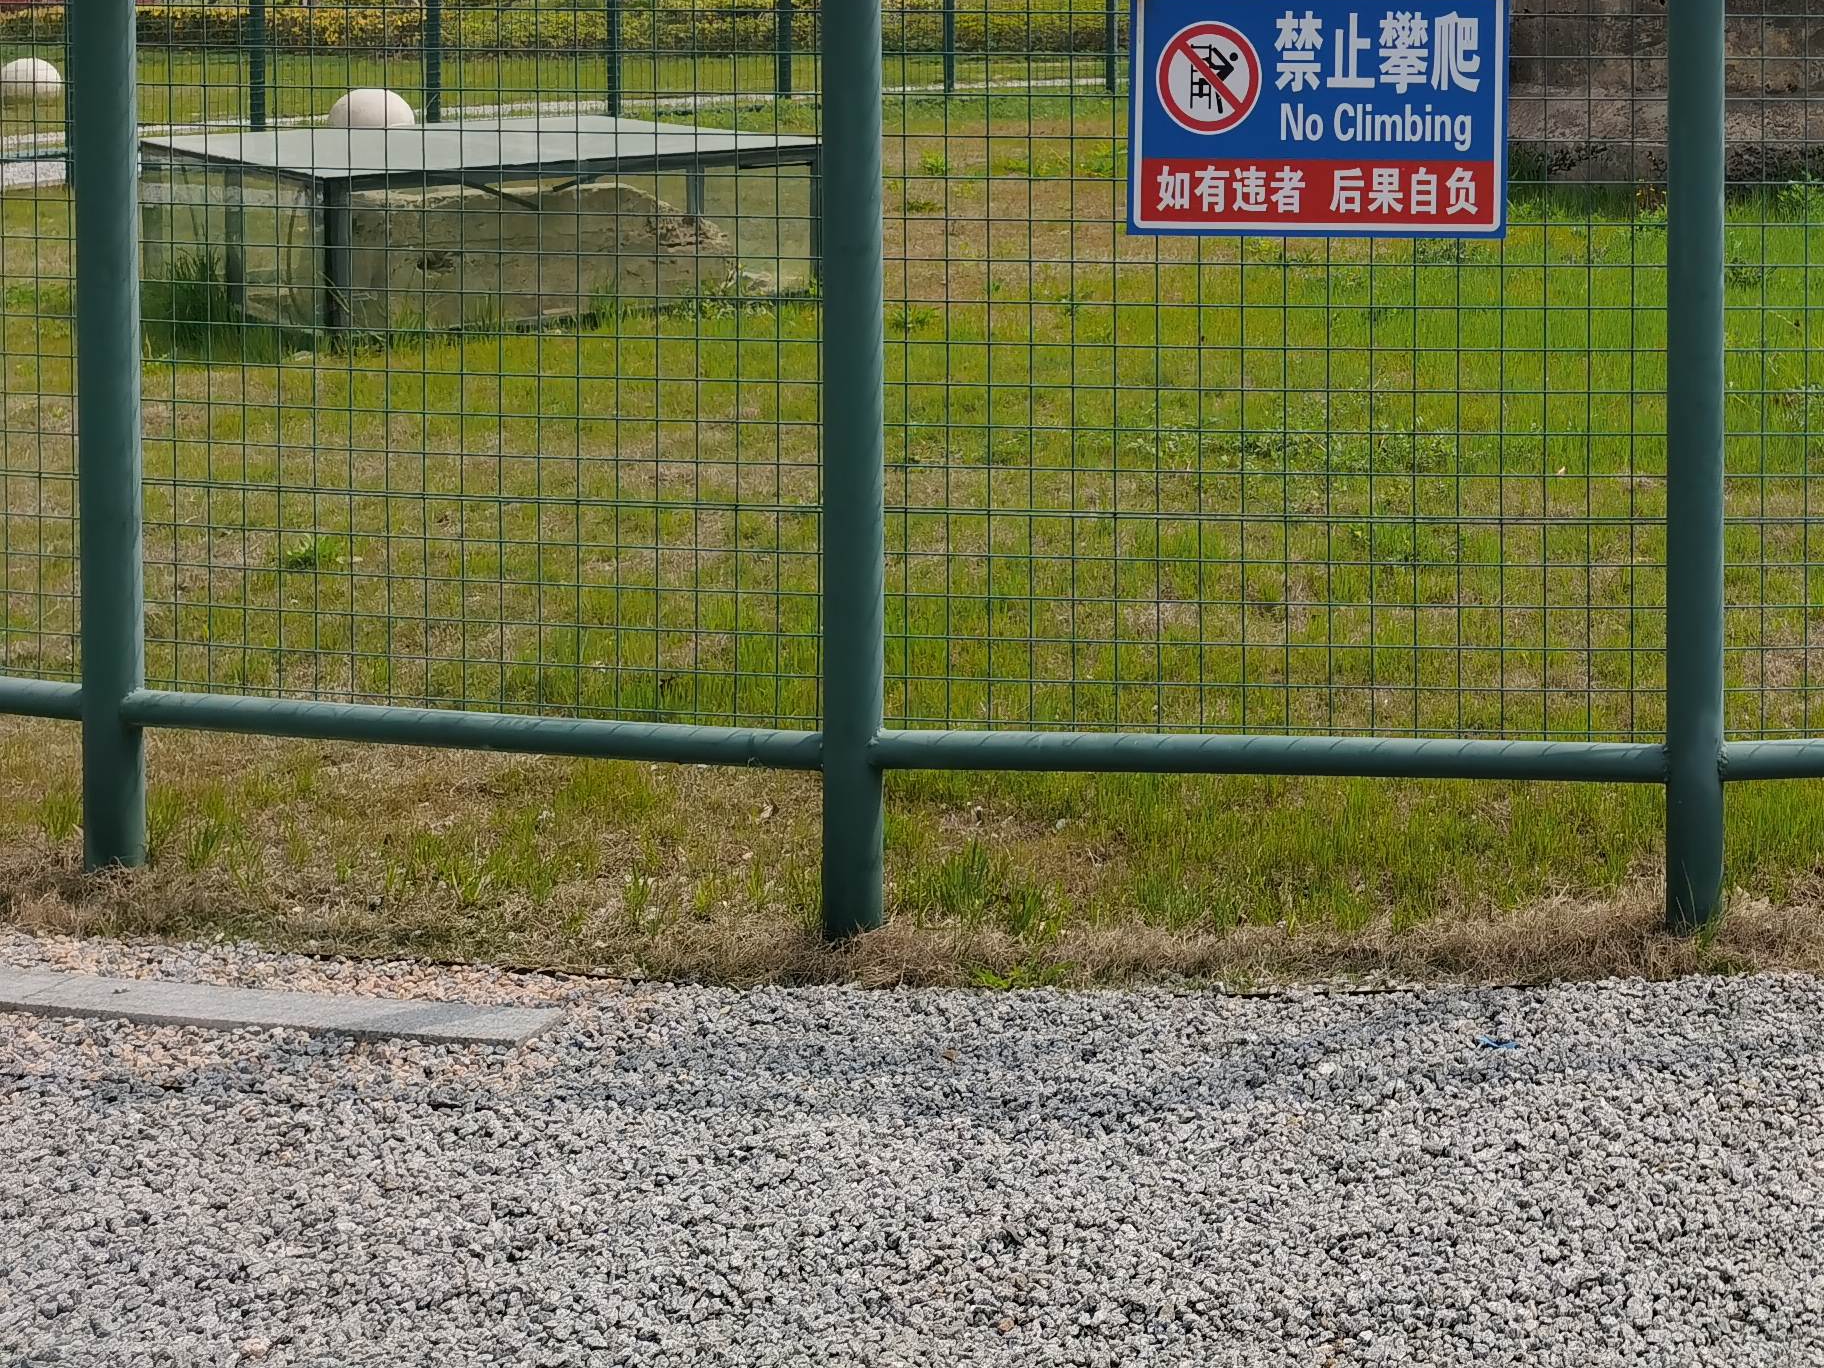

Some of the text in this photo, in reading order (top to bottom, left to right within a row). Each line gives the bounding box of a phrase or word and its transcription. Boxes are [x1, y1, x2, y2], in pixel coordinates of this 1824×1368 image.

[1274, 10, 1481, 94] 禁止攀爬
[1280, 103, 1472, 152] No Climbing
[1156, 165, 1478, 215] 如有违者 后果自负
